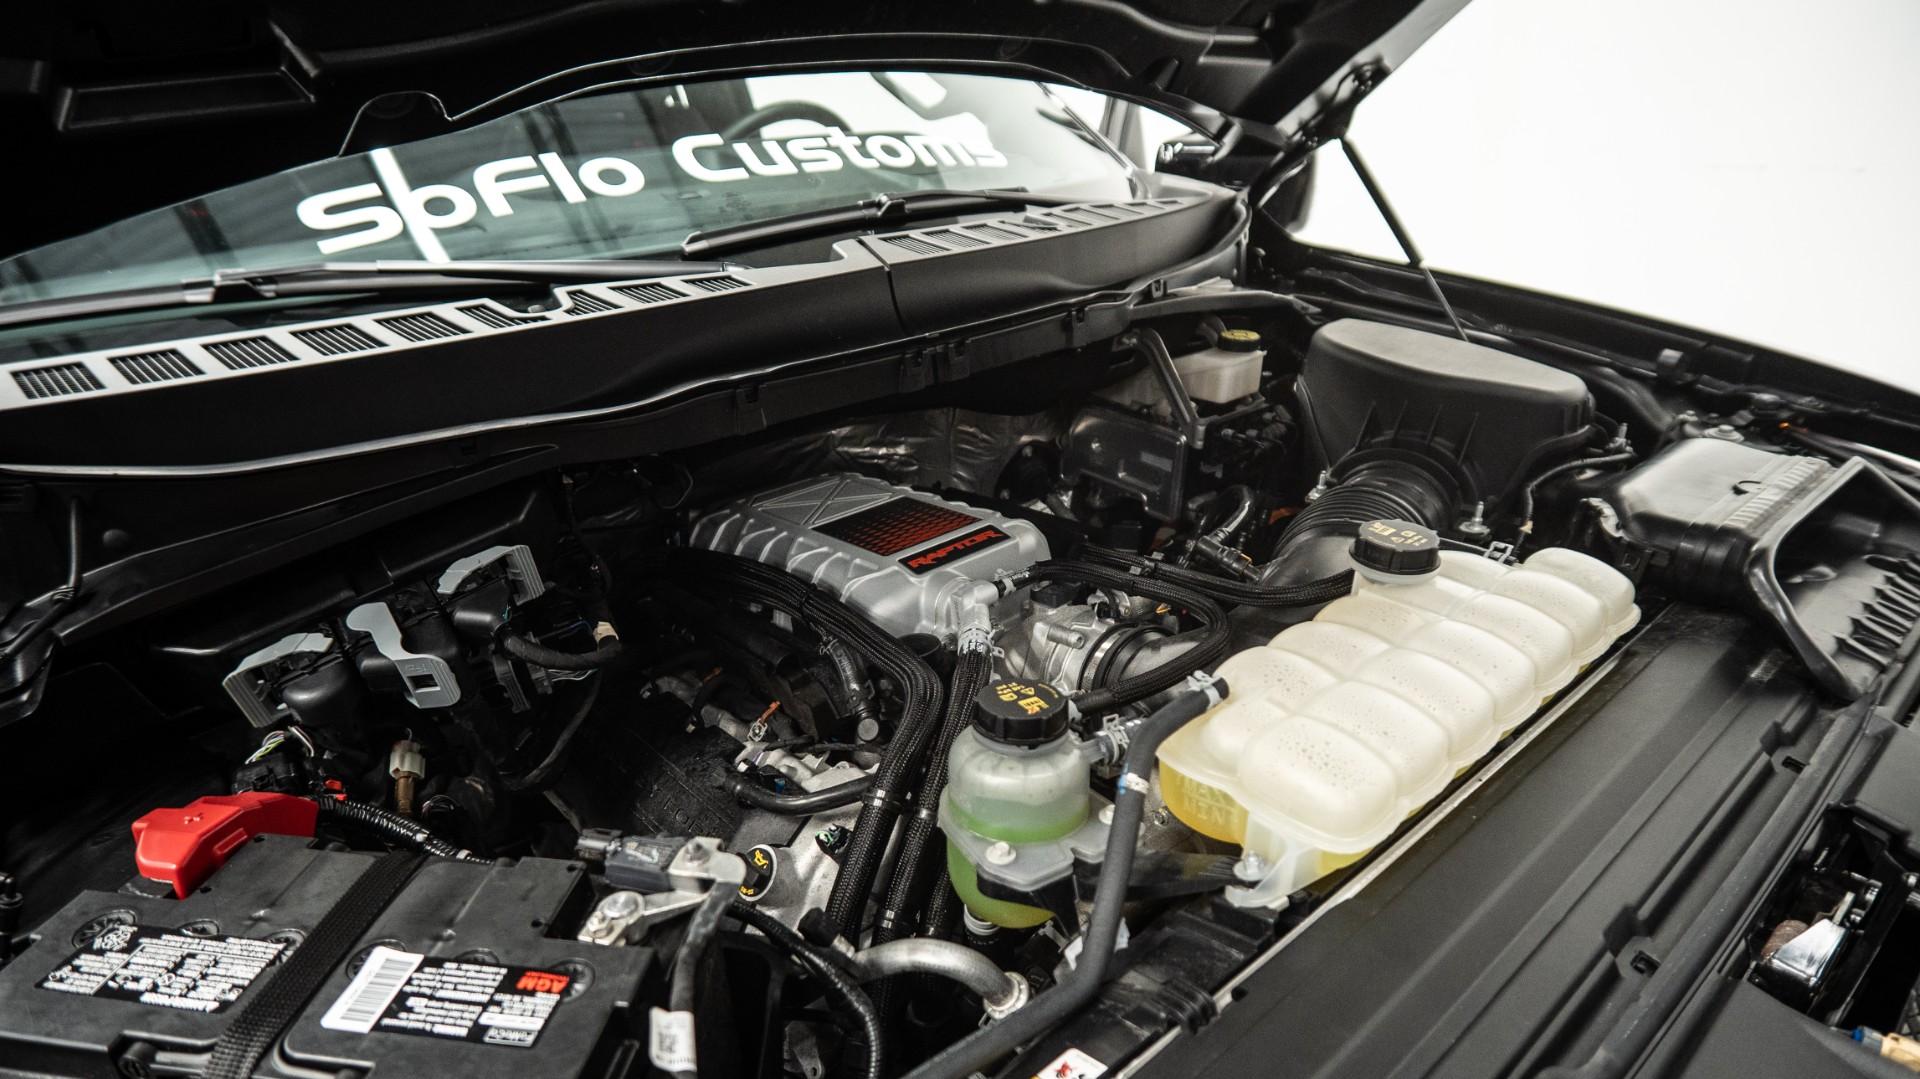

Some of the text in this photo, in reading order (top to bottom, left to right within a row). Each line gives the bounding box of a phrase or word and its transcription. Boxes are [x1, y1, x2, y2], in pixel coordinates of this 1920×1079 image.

[672, 127, 1008, 184] Customs
[908, 530, 1003, 567] RAPTOR
[516, 976, 569, 994] AGM
